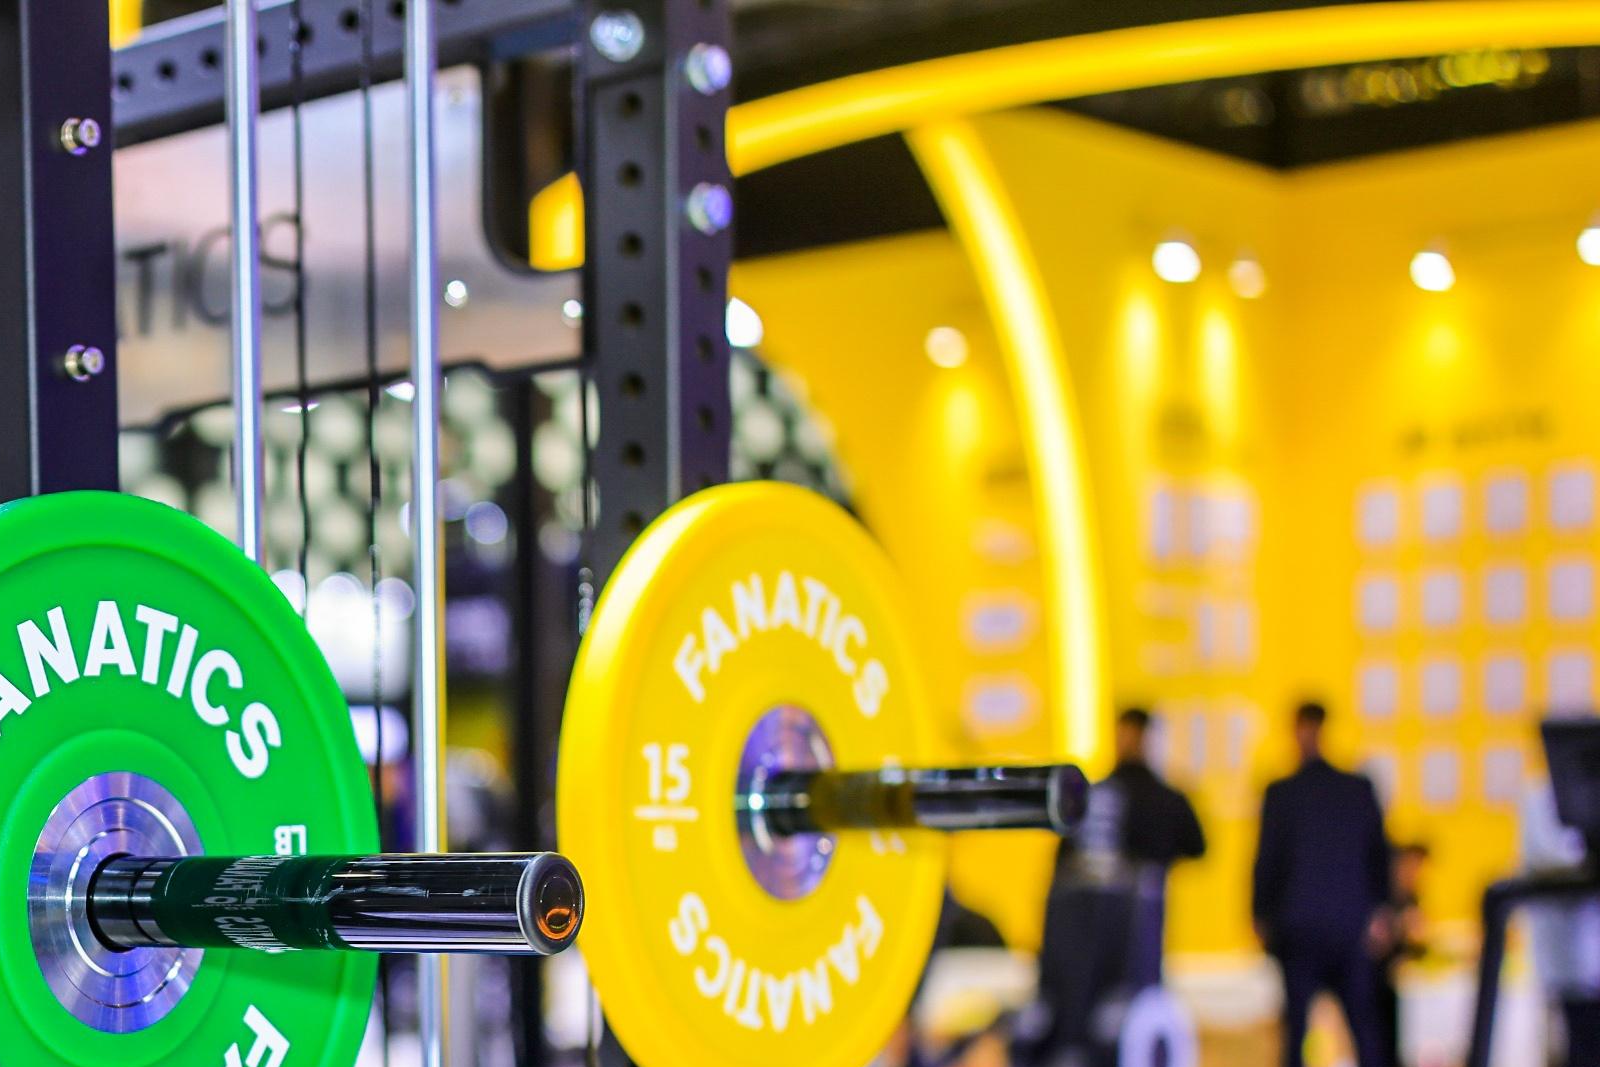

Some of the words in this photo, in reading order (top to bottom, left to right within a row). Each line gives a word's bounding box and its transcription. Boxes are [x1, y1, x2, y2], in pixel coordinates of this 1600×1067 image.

[672, 569, 889, 719] FANATICS
[642, 743, 691, 801] 15
[274, 824, 307, 856] LB
[668, 891, 884, 1034] FANATICS
